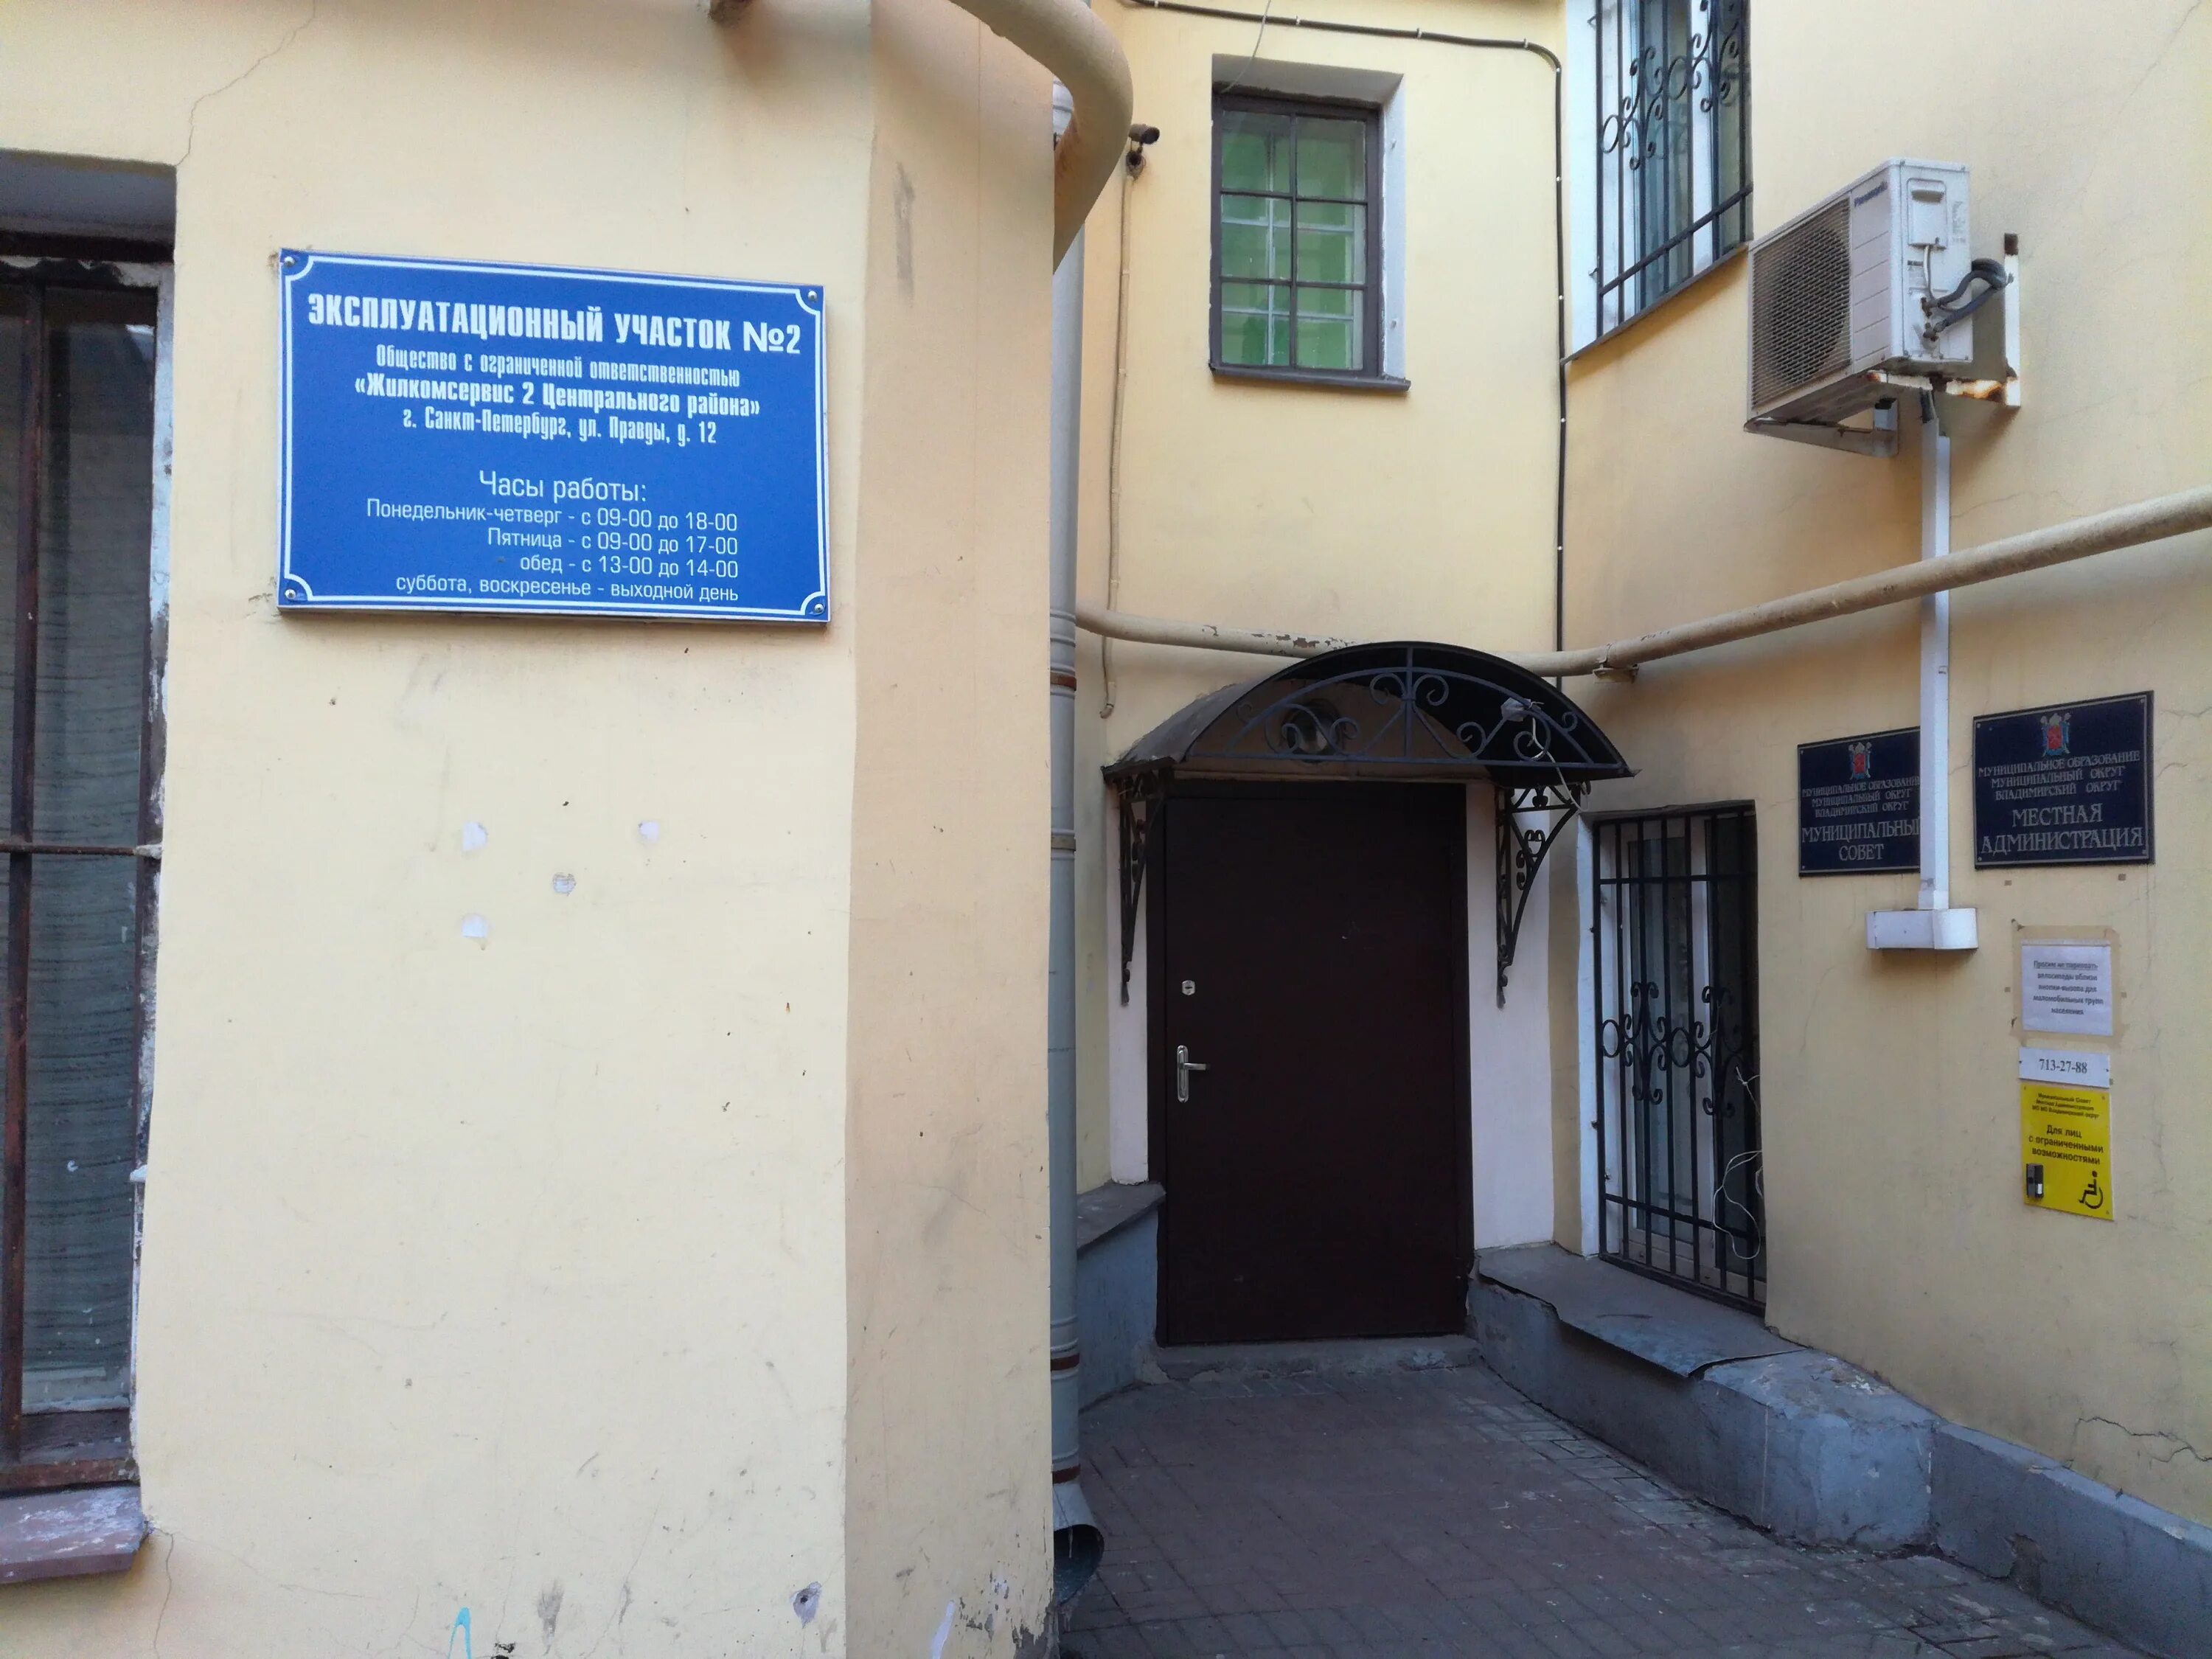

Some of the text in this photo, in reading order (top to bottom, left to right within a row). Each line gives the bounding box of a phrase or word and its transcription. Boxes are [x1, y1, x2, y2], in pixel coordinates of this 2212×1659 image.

[308, 293, 801, 354] ЭКСПЛУАТАЦИОННЫЙ УЧАСТОК №2
[376, 344, 740, 387] Общество с ограниченной ответственностью
[355, 372, 759, 419] «Жилкомсервис 2 Центрального района»
[403, 406, 717, 447] г. Санкт-Петербург, ул. Правды, д. 12
[479, 470, 646, 503] Часы работы:
[367, 498, 562, 527] Понедельник-четверг
[581, 511, 591, 525] с
[597, 508, 652, 527] 09-00
[658, 515, 678, 531] до
[686, 512, 737, 532] 18-00
[488, 527, 562, 550] Пятница
[581, 535, 591, 549] с
[597, 532, 653, 551] 09-00
[658, 539, 678, 554] до
[686, 535, 737, 554] 17-00
[520, 554, 563, 574] обед
[582, 559, 591, 573] с
[599, 555, 653, 574] 13-00
[658, 563, 679, 578] до
[686, 559, 738, 578] 14-00
[396, 574, 472, 594] суббота,
[480, 579, 591, 597] воскресенье
[611, 583, 693, 600] выходной
[700, 586, 738, 602] день
[1978, 750, 2140, 776] МУНИЦИПАЛЬНОЕ ОБРАЗОВАНИЕ
[1992, 765, 2126, 788] МУНИЦИПАЛЬНЫЙ ОКРУГ
[1802, 782, 1867, 797] МУНИЦИПАЛЬНОЕ
[1812, 789, 1911, 808] МУНИЦИПАЛЬНЫЙ ОКРУГ
[1995, 780, 2123, 801] ВЛАДИМИРСКИЙ ОКРУГ
[1815, 801, 1909, 818] ВЛАДИМИРСКИЙ ОКРУГ
[2012, 803, 2103, 827] МЕСТНАЯ
[1839, 844, 1884, 861] СОВЕТ
[1980, 827, 2143, 856] АДМИНИСТРАЦИЯ
[2039, 1058, 2087, 1074] 713-27-88
[2047, 1124, 2081, 1138] Для лиц
[2032, 1148, 2100, 1164] возможностями
[2036, 1136, 2104, 1152] ограниченными
